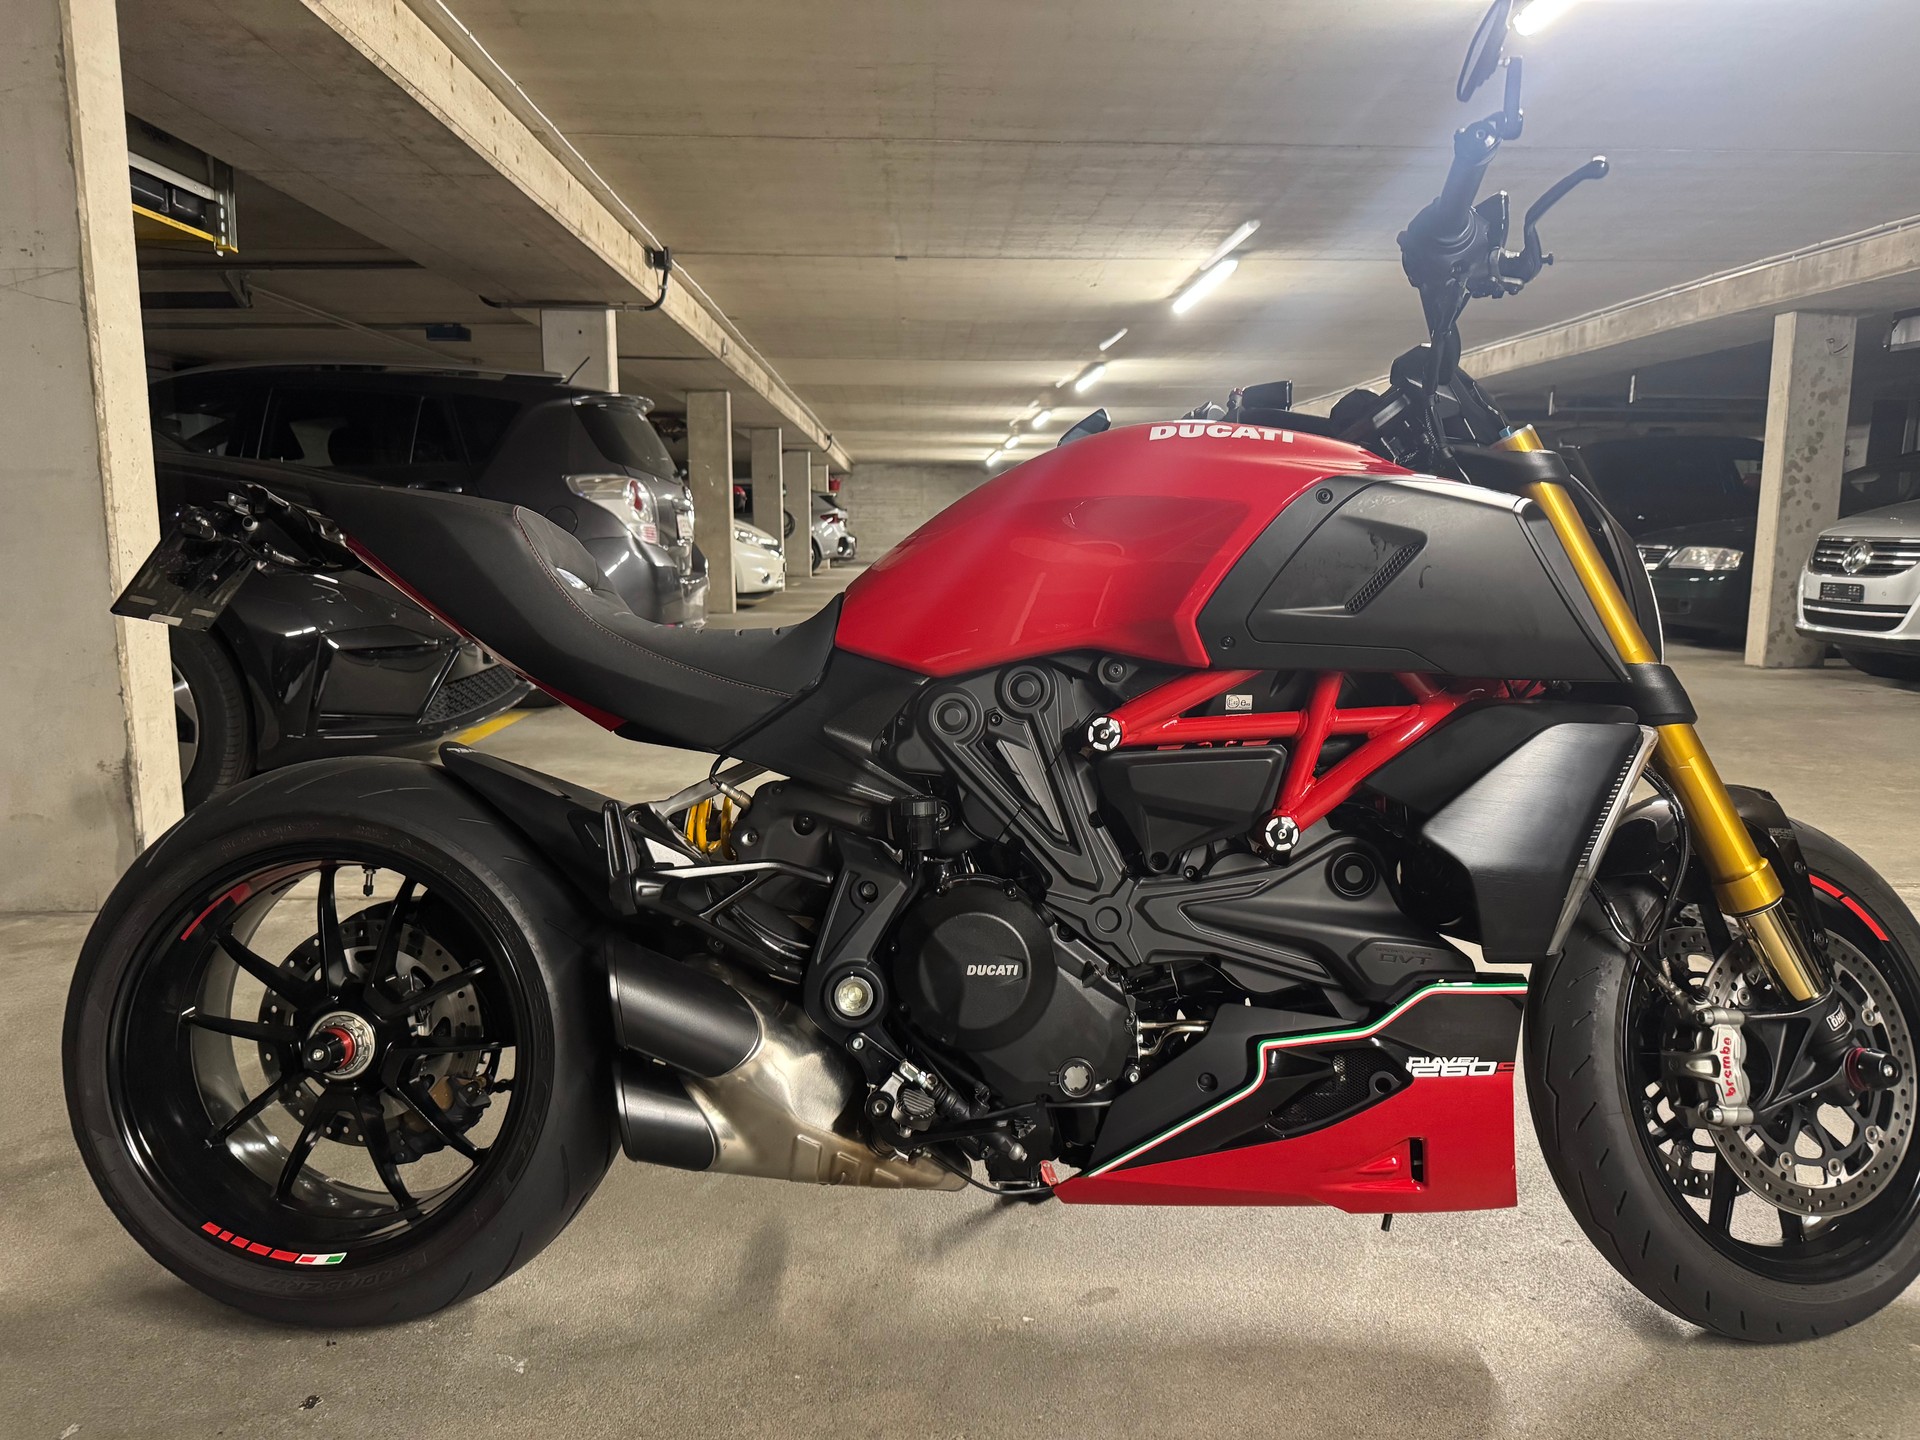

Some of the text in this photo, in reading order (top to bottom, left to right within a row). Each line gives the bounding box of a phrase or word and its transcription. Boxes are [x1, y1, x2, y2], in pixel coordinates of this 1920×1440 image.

[1149, 424, 1294, 444] DUCATI
[1379, 953, 1433, 966] DVT
[966, 964, 1019, 976] DUCATI
[1720, 1037, 1737, 1097] brembo
